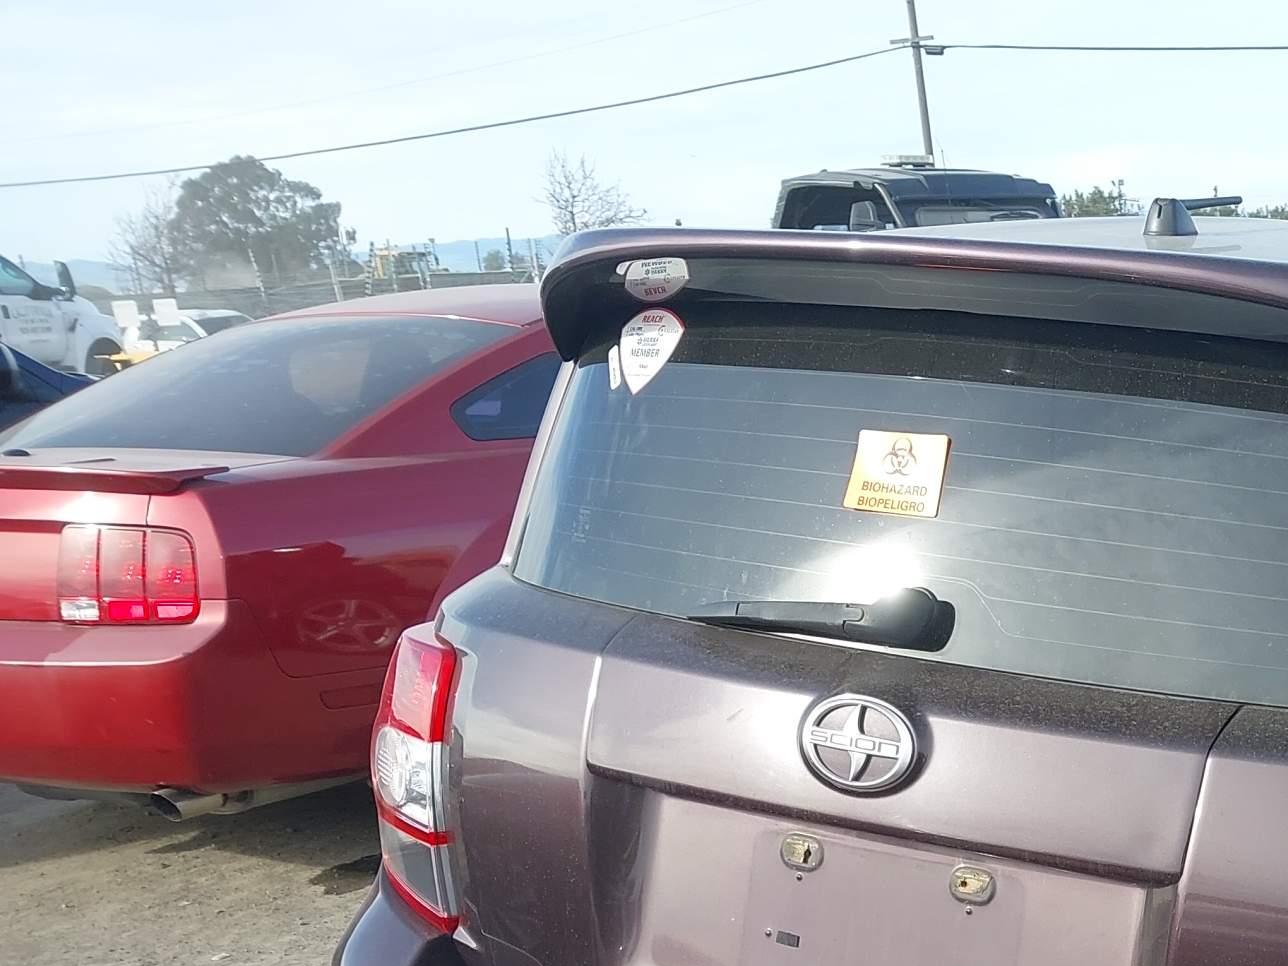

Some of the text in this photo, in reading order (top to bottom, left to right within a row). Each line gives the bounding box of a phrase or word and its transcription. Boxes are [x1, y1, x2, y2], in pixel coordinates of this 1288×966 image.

[641, 314, 664, 324] REACH
[631, 348, 661, 358] MEMBER
[861, 481, 928, 497] BIOHAZARD
[857, 496, 925, 512] BIOPELIGRO
[809, 729, 900, 756] SCION
